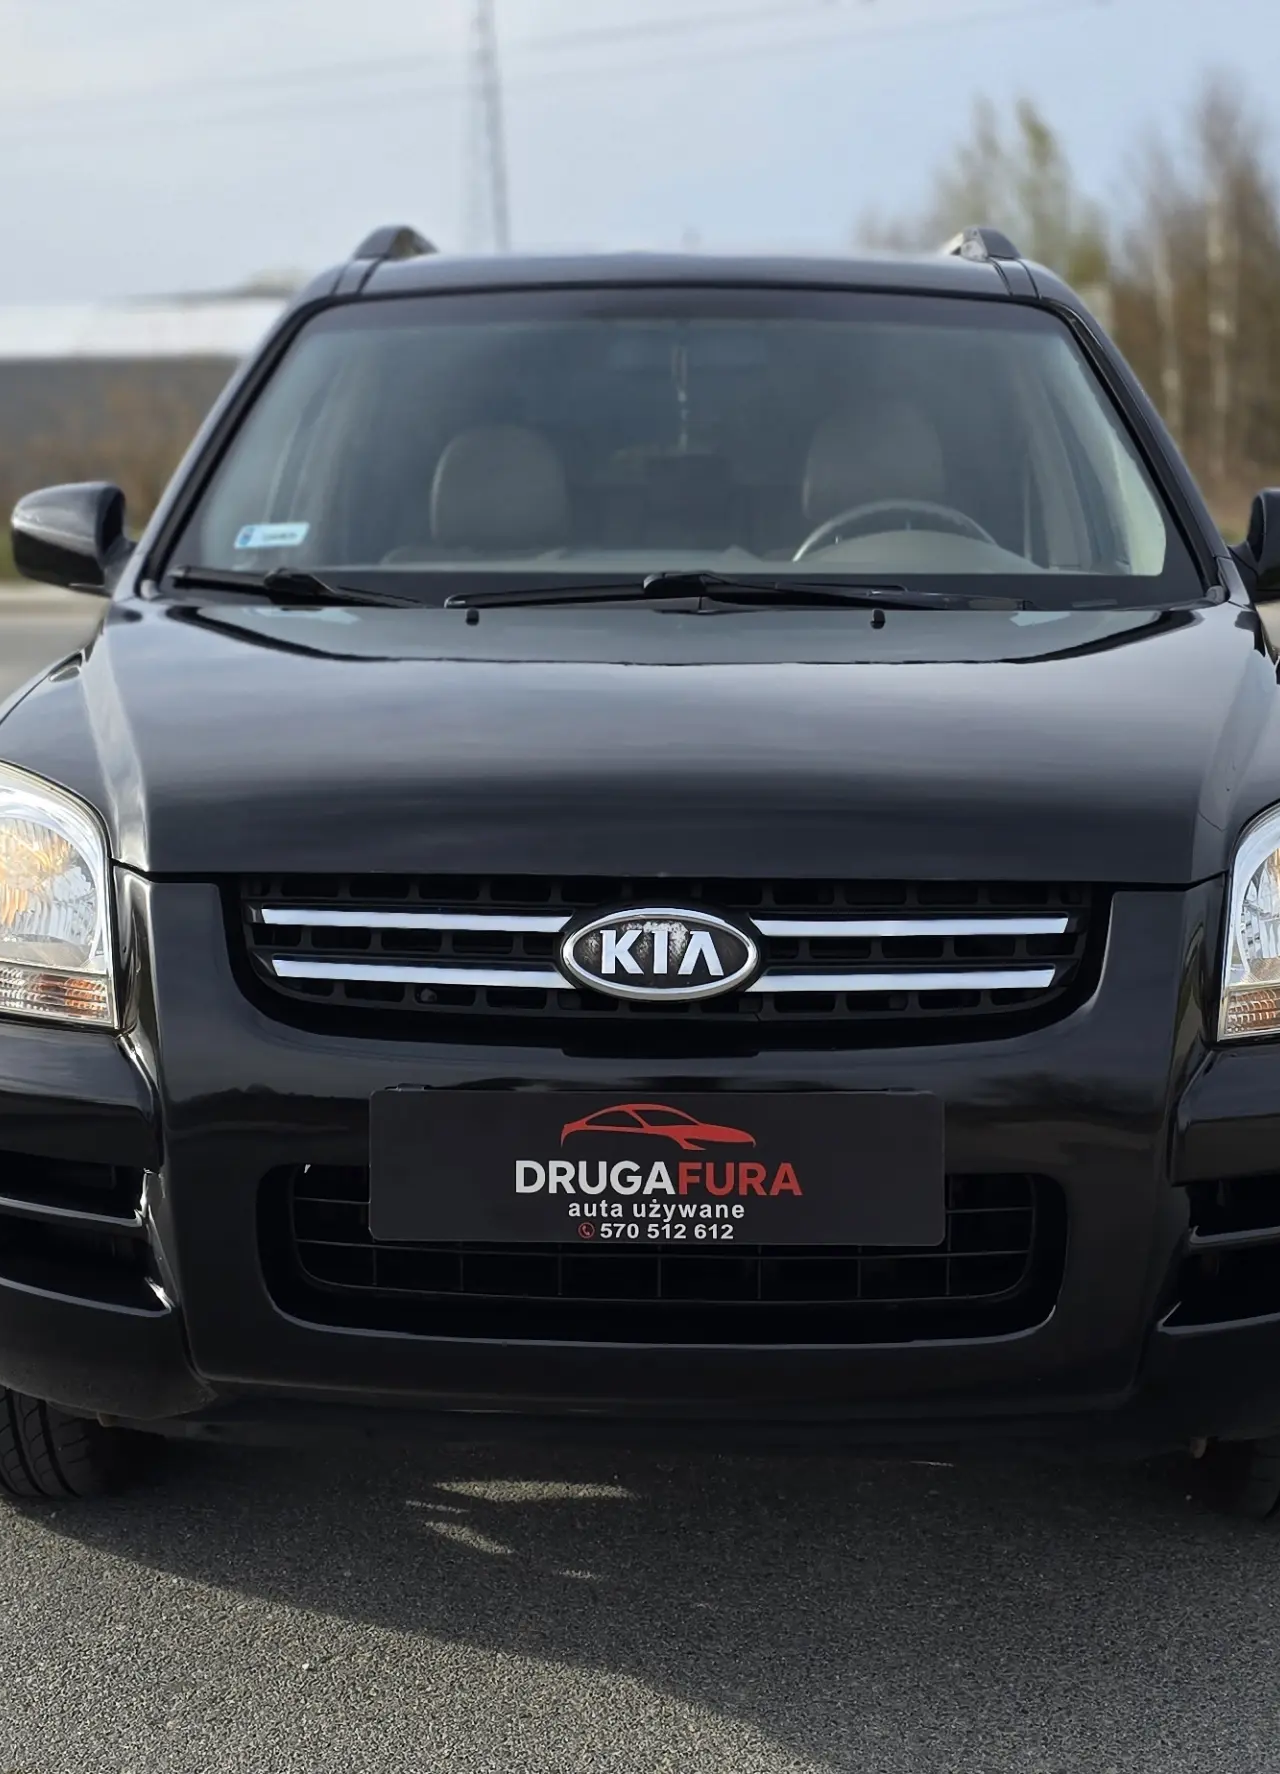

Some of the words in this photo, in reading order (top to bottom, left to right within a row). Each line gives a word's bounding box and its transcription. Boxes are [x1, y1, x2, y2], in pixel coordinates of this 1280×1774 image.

[516, 1160, 803, 1196] DRUGAFURA
[568, 1200, 624, 1219] auta
[632, 1199, 746, 1223] używane
[599, 1222, 640, 1239] 570
[646, 1223, 688, 1239] 512
[694, 1223, 734, 1240] 612
